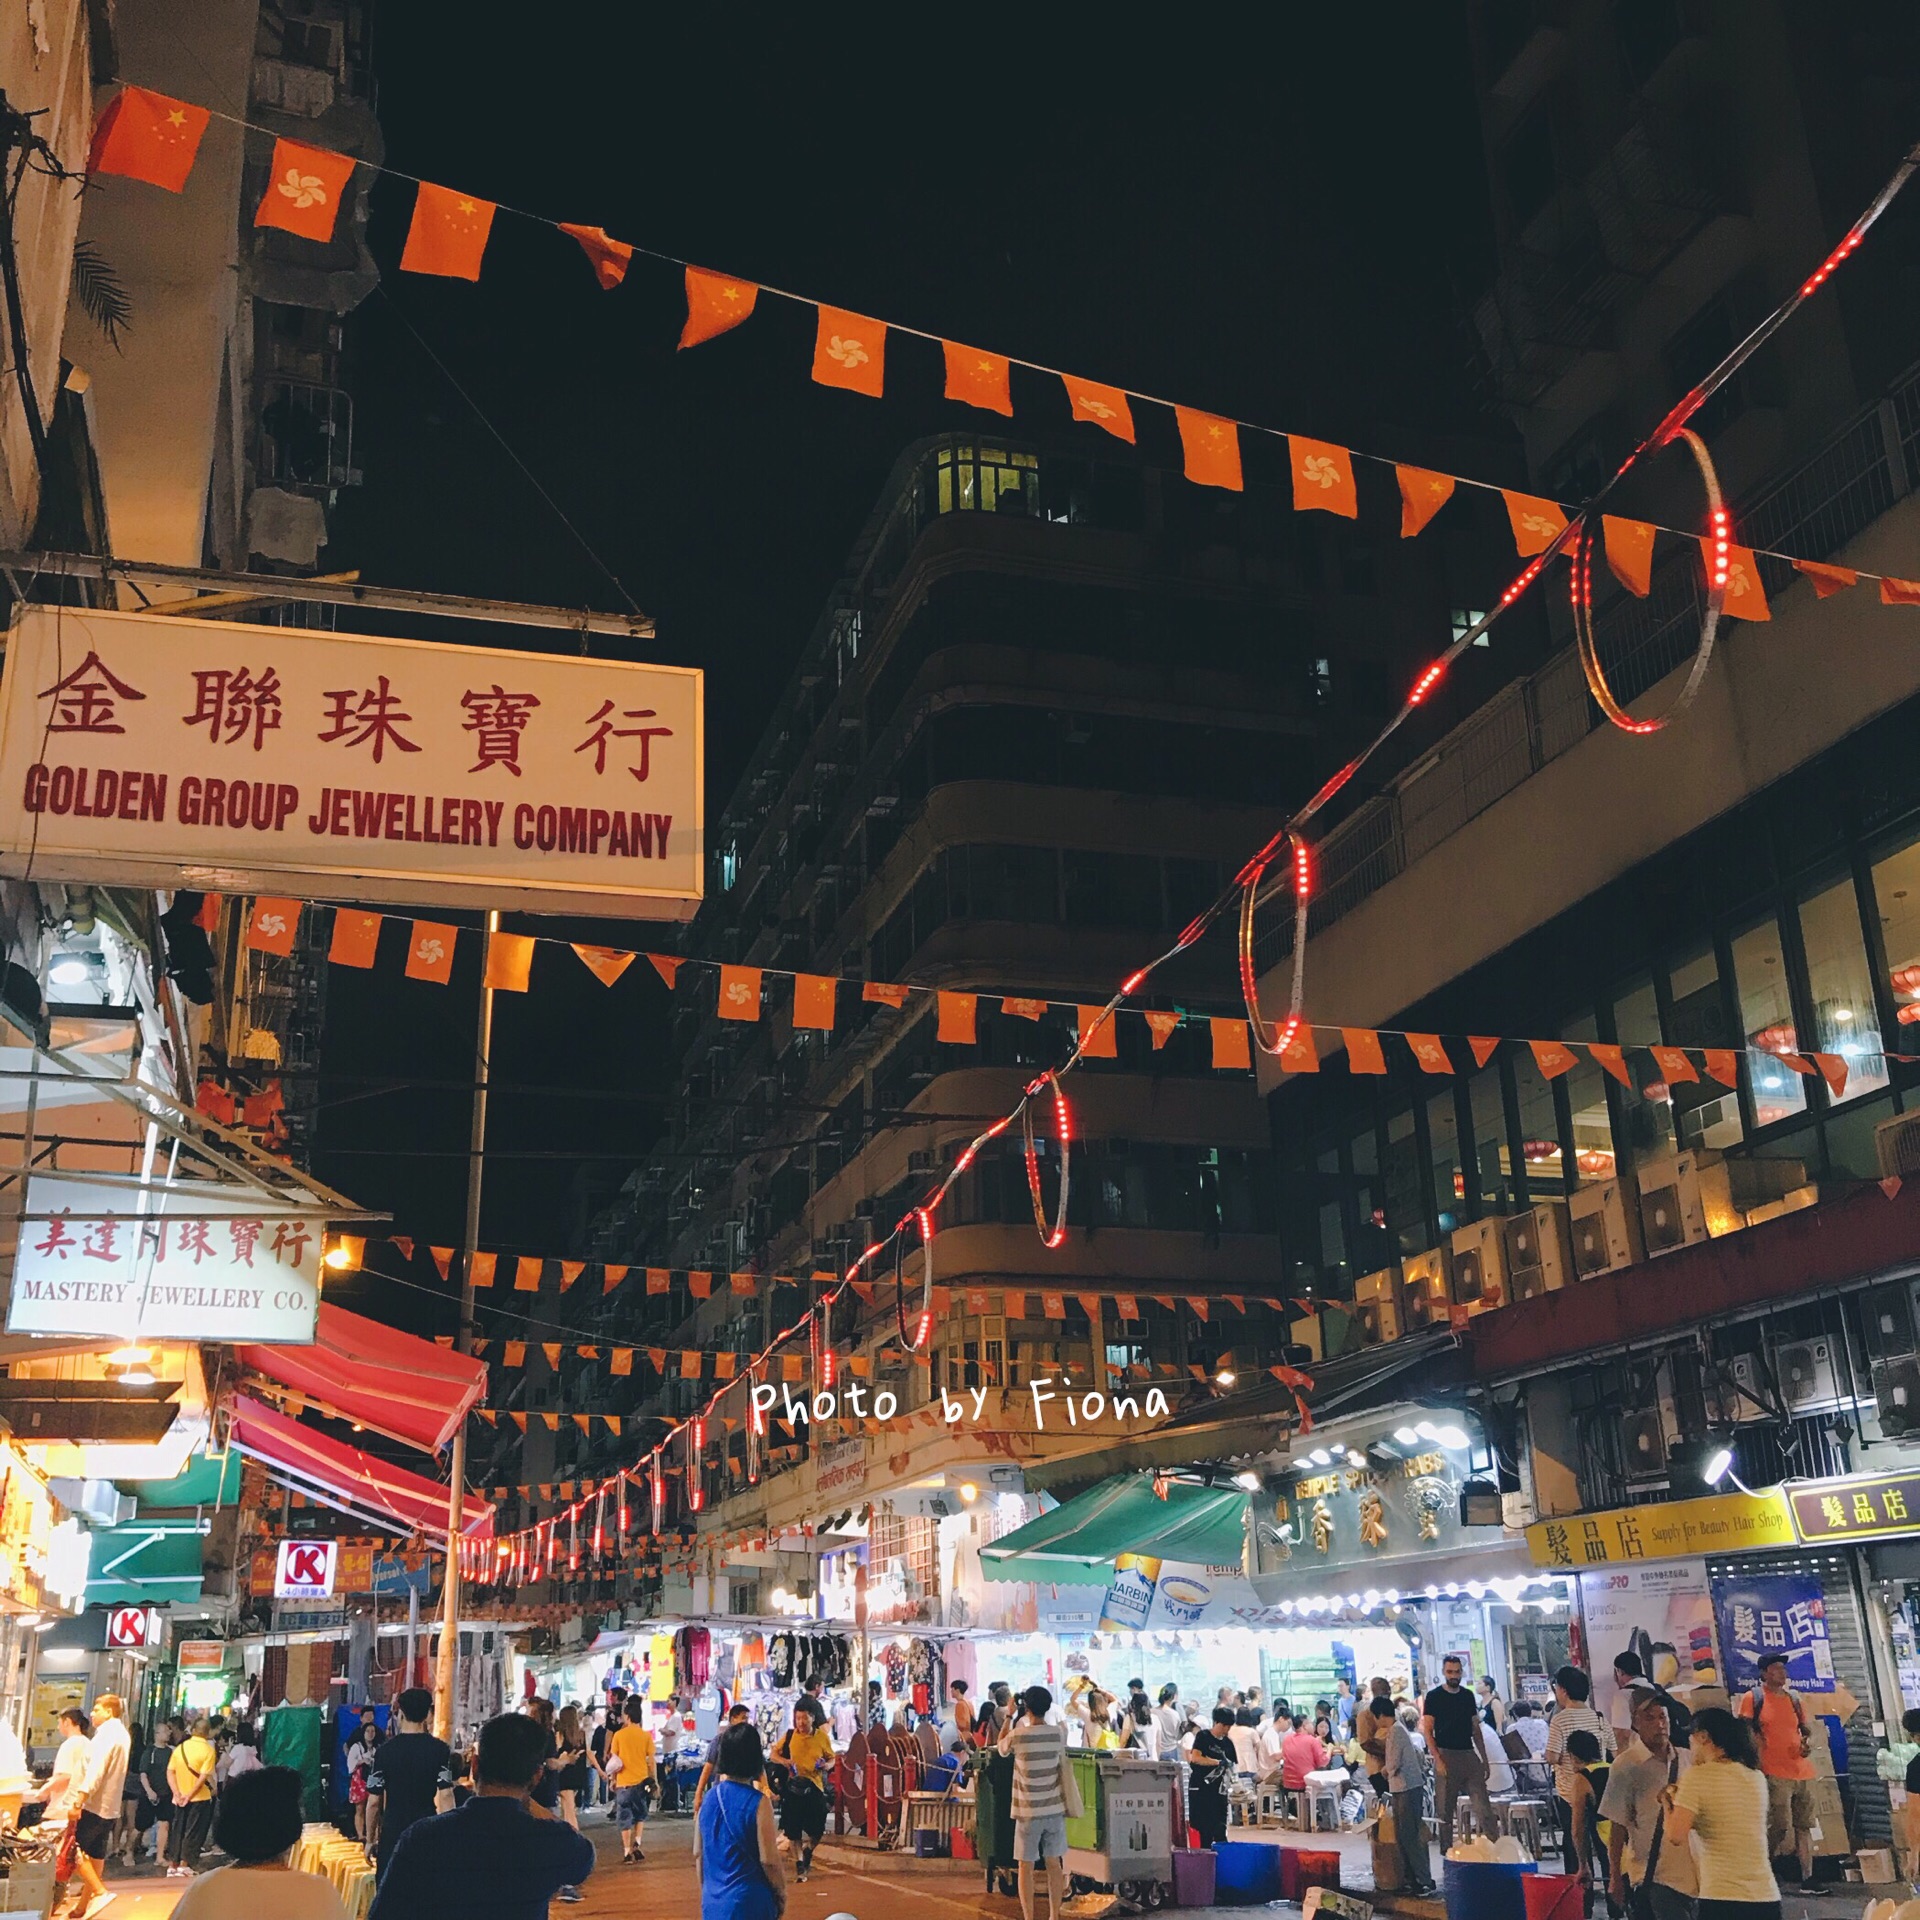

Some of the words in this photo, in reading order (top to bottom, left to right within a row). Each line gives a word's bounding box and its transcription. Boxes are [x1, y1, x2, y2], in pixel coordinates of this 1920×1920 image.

[37, 651, 674, 783] 金聯珠寶行
[24, 763, 168, 822] GOLDEN
[178, 776, 299, 832] GROUP
[308, 788, 504, 848] JEWELLERY
[513, 803, 673, 860] COMPANY
[22, 1280, 128, 1303] MASTERY
[274, 1290, 308, 1311] CO.
[1401, 1451, 1446, 1478] RABS
[1652, 1525, 1681, 1542] Supply
[1684, 1521, 1696, 1541] for
[1700, 1519, 1730, 1537] Beauty
[1733, 1516, 1754, 1532] Hair
[1758, 1513, 1783, 1530] Shop
[1820, 1489, 1907, 1527] 髮品店
[1546, 1515, 1645, 1565] 髮品店
[1734, 1602, 1815, 1647] 髮品店
